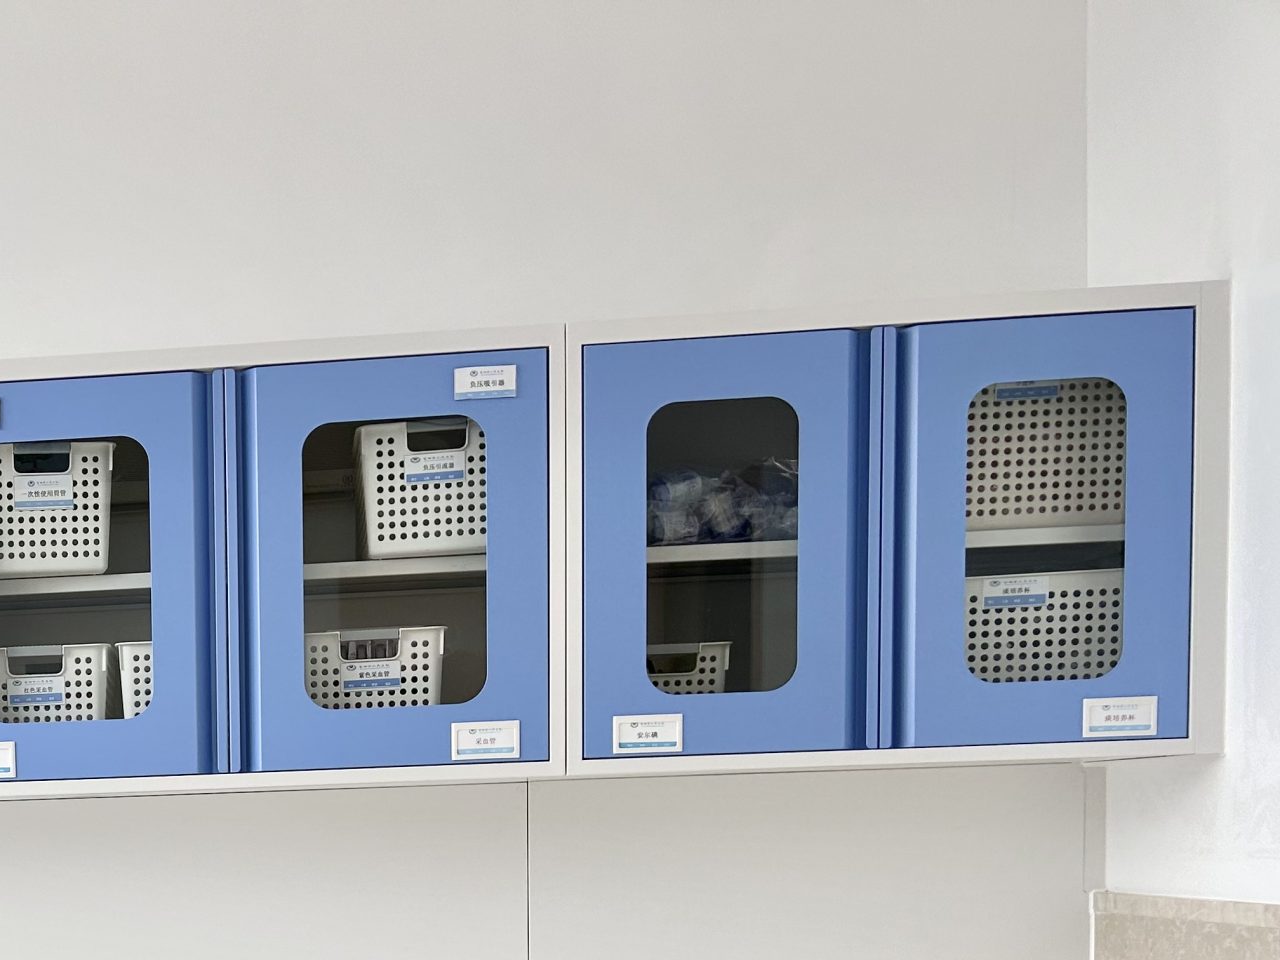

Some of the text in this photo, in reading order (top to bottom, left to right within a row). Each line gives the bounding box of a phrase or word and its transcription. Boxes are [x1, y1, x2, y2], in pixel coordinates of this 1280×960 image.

[469, 380, 505, 388] 负压吸引器
[475, 737, 496, 745] 采血管
